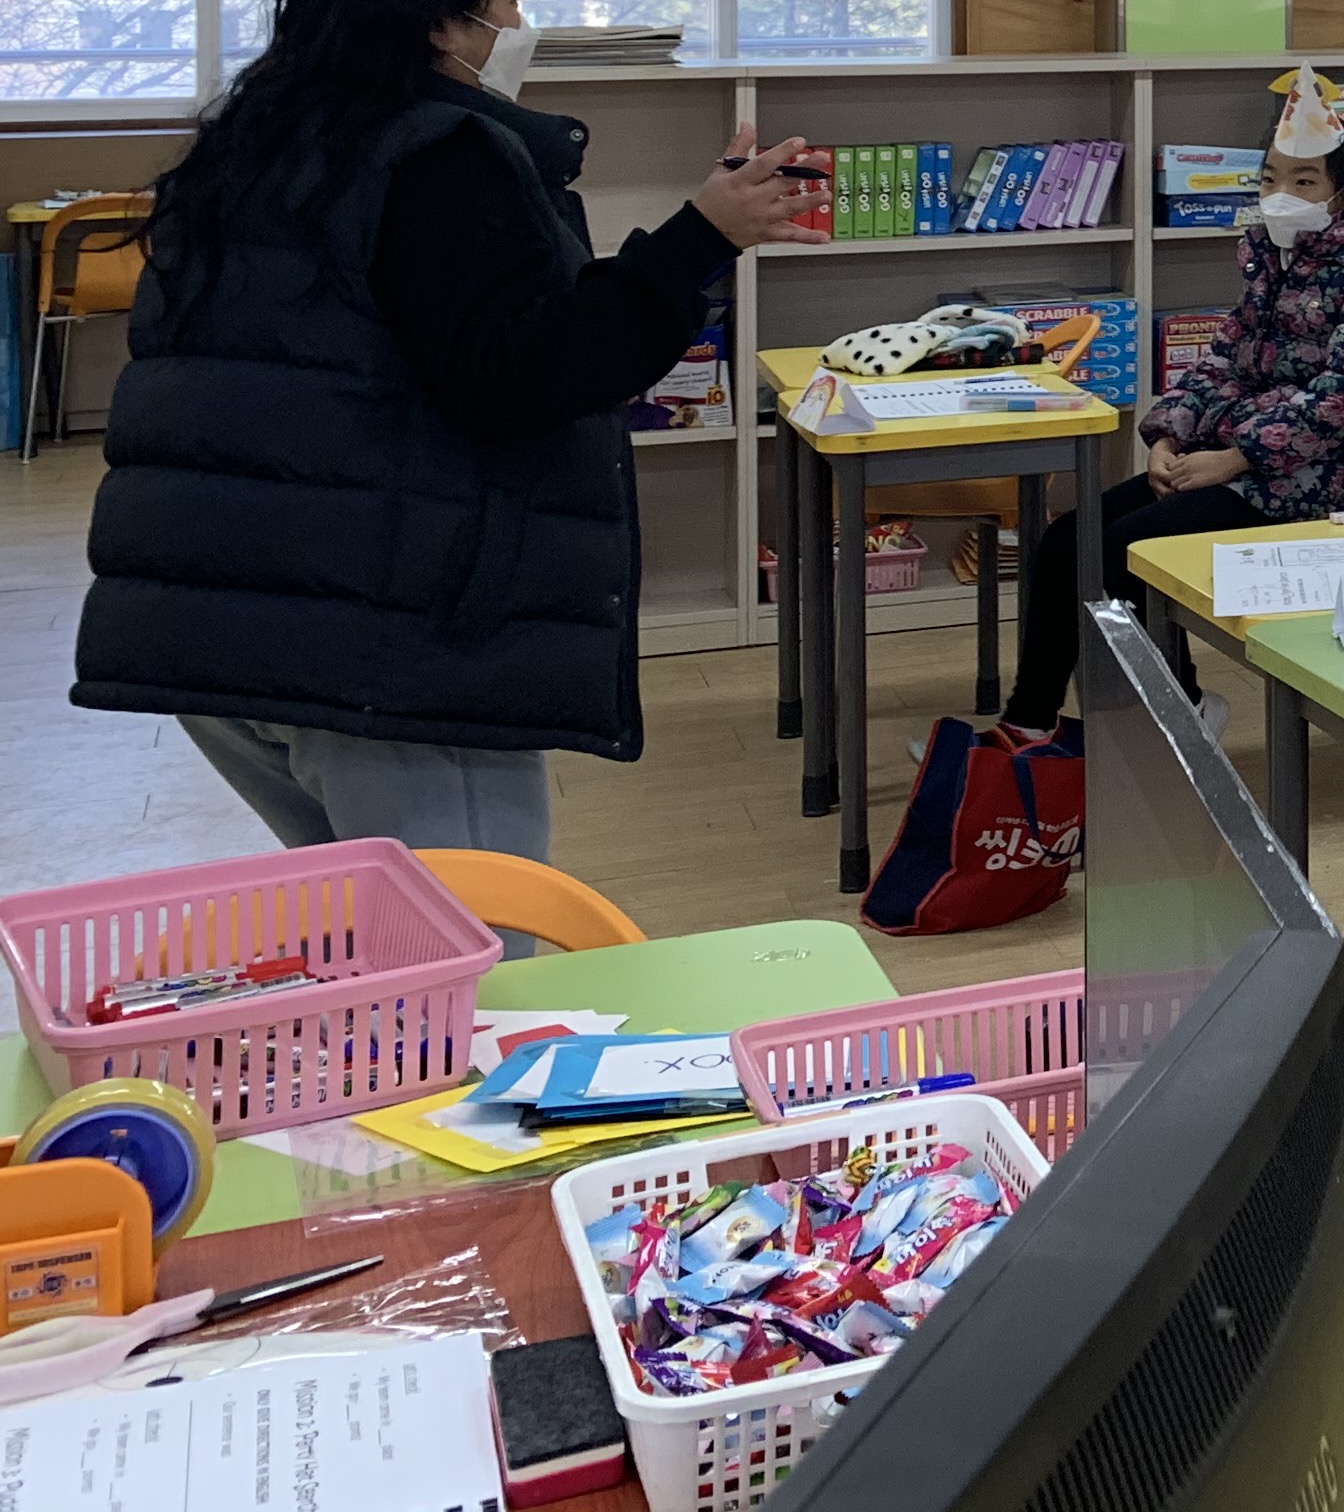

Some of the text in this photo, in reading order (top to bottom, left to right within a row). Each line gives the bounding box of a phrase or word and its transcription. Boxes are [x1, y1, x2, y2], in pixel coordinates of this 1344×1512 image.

[1015, 306, 1090, 321] SCRABBLE
[294, 1379, 318, 1418] Mission
[293, 1431, 320, 1459] Party
